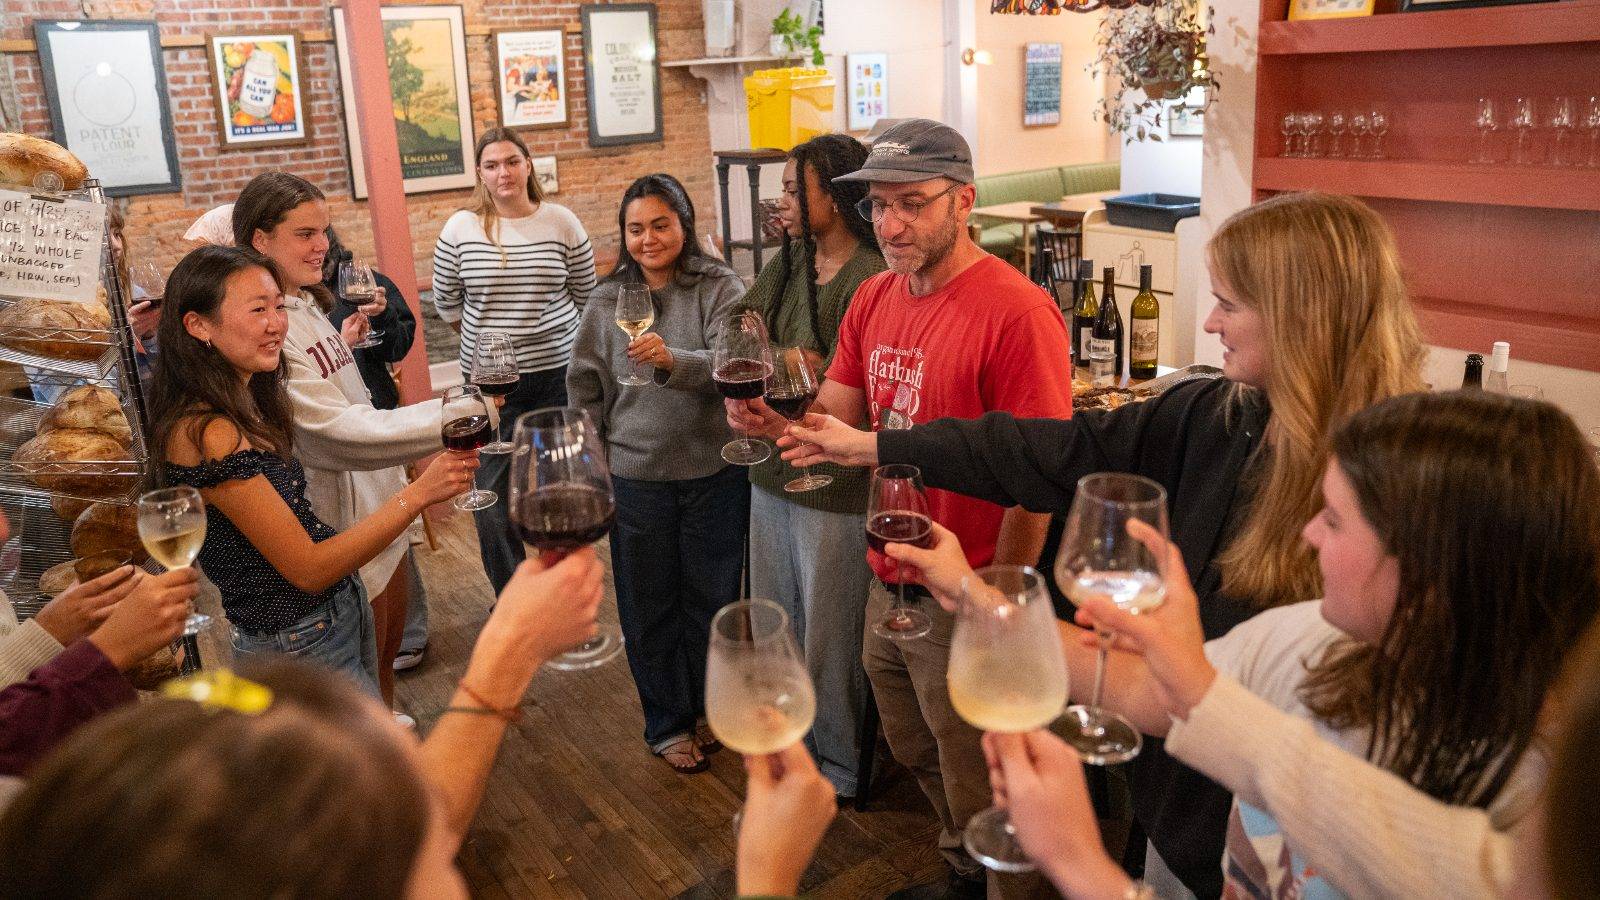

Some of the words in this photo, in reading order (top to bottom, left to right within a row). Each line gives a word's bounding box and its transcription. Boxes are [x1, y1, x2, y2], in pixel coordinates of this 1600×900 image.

[254, 78, 267, 86] CAN
[611, 73, 642, 82] SALT
[246, 84, 257, 92] ALL
[250, 94, 263, 102] CAN
[80, 126, 142, 142] PATENT
[92, 138, 135, 153] FLOUR
[403, 152, 449, 165] ENGLAND
[4, 200, 21, 212] OF
[35, 244, 84, 260] WHOLE
